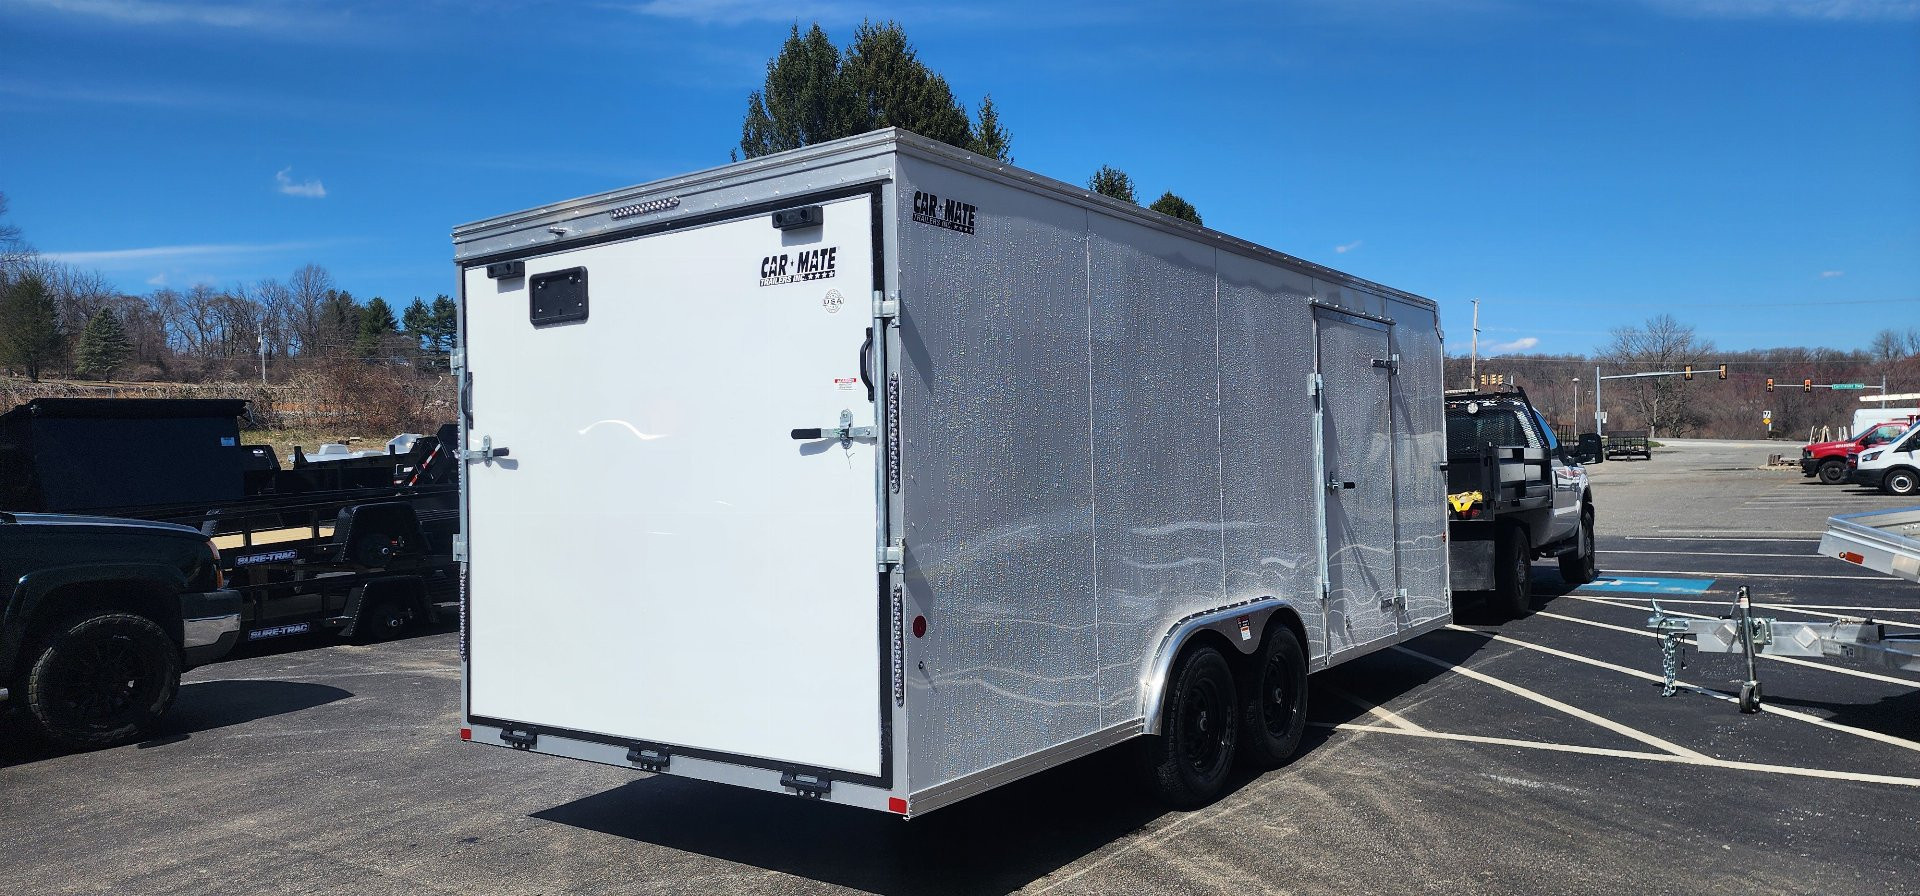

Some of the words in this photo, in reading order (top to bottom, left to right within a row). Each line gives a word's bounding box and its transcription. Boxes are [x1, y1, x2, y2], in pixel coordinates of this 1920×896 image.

[914, 191, 937, 217] CAR
[945, 199, 976, 227] MATE
[913, 213, 941, 227] TRAILERS
[761, 254, 788, 278] CAR
[797, 247, 837, 273] MATE
[760, 275, 792, 287] TRAILERS
[237, 550, 296, 566] SURE-TRAC
[250, 624, 308, 639] SURE-TRAC
